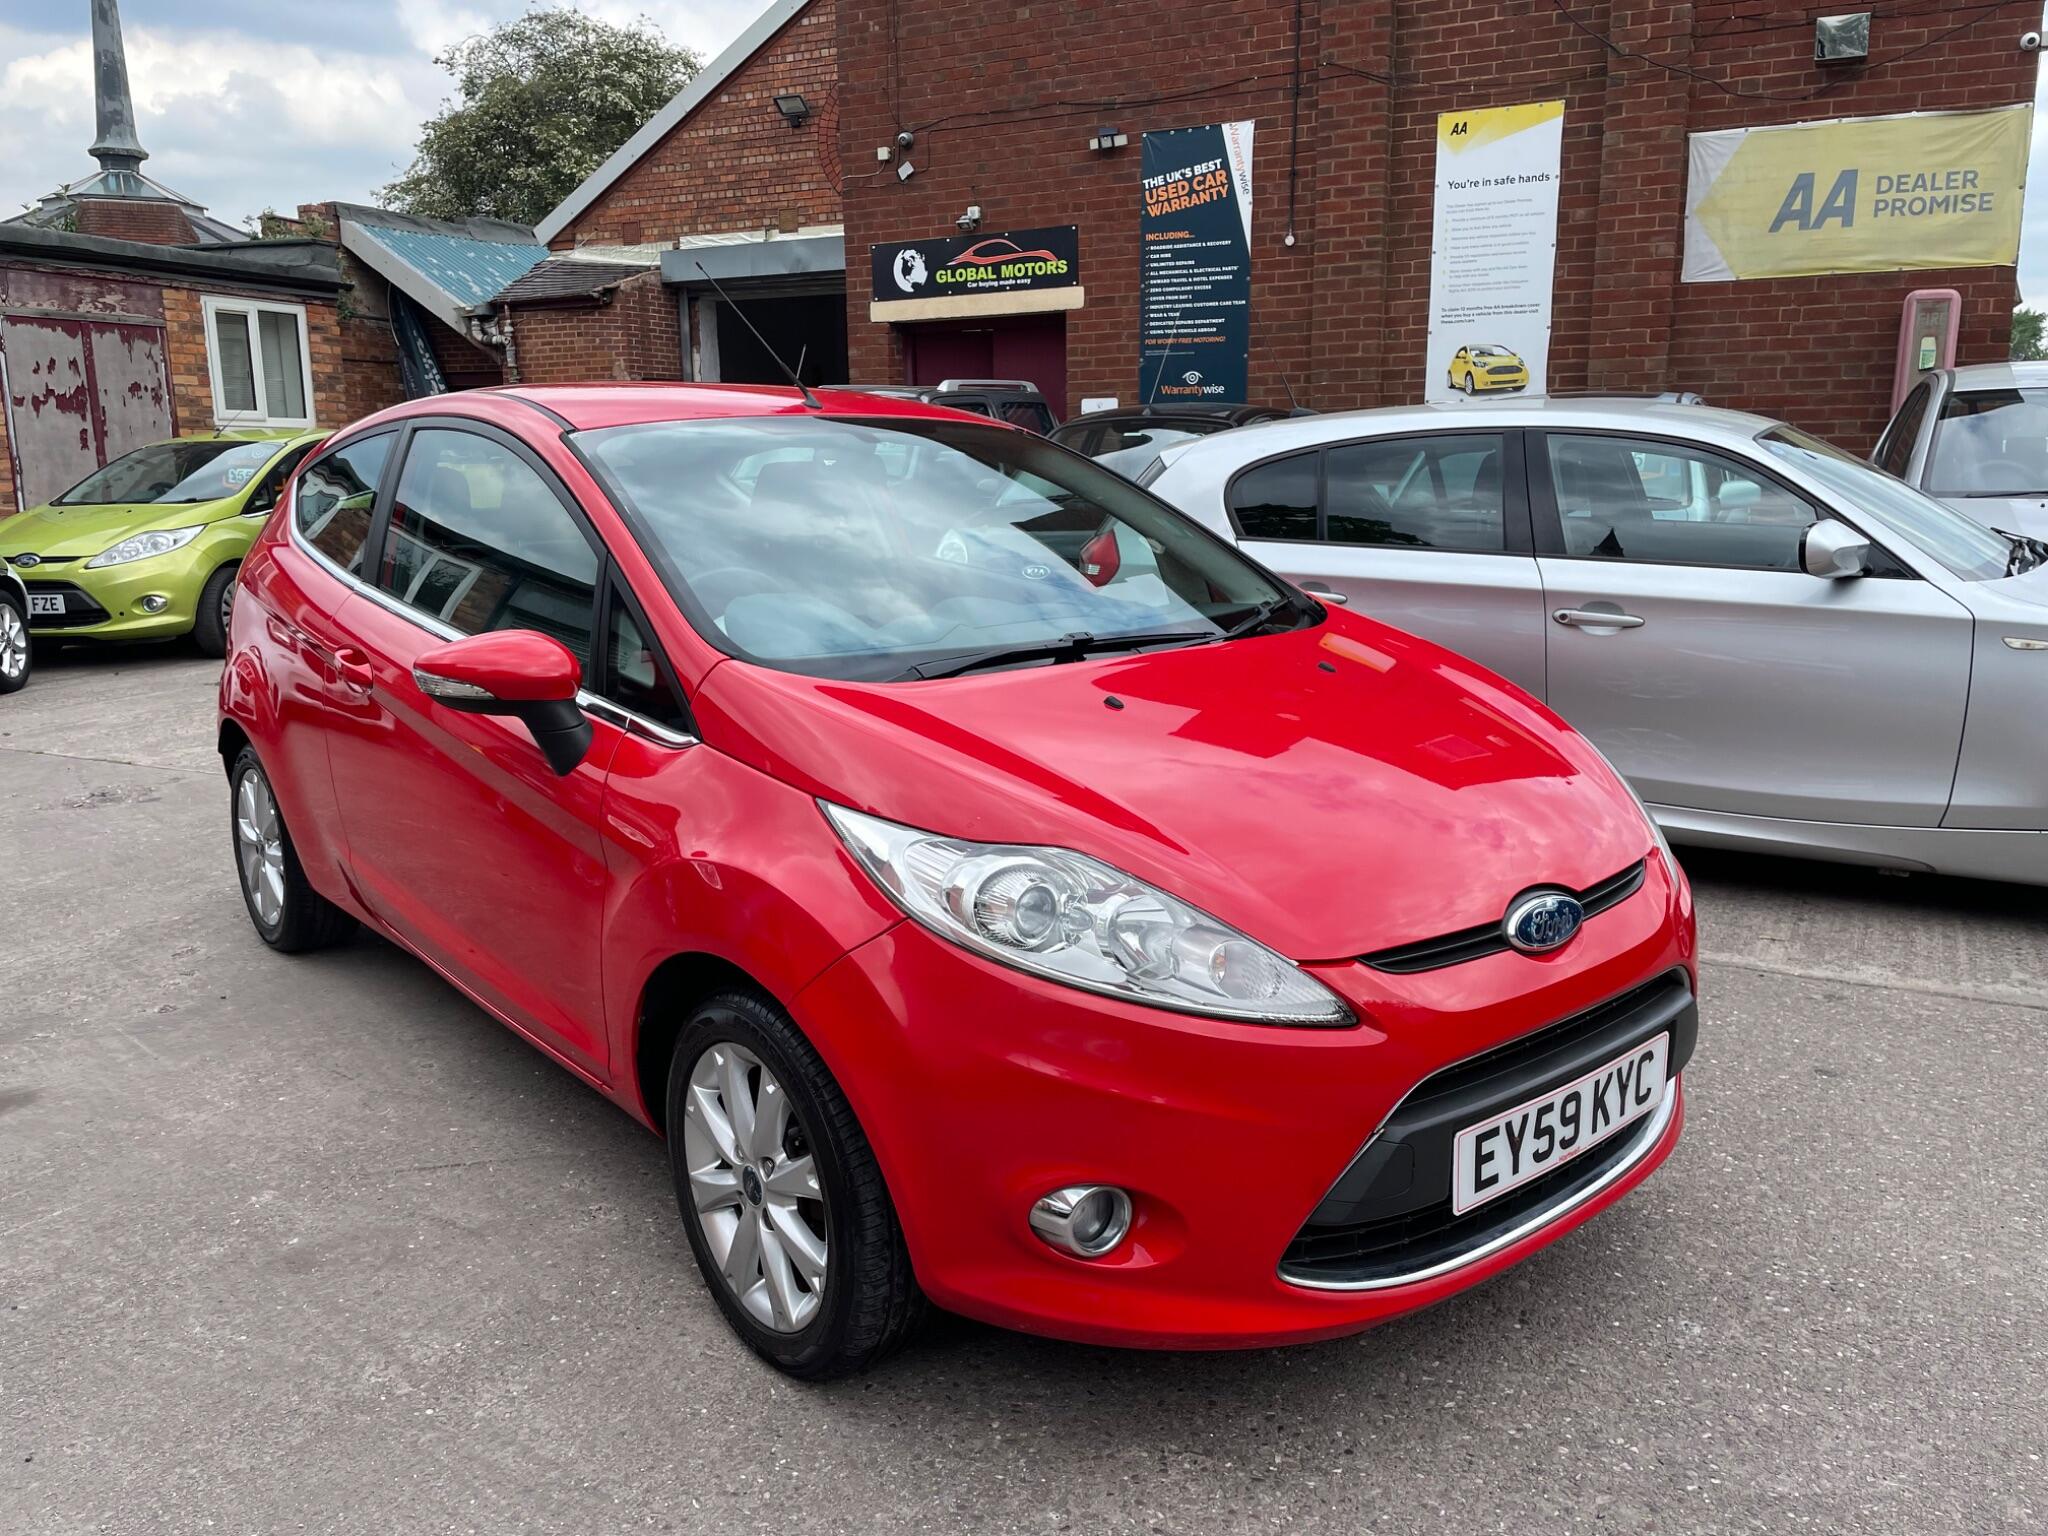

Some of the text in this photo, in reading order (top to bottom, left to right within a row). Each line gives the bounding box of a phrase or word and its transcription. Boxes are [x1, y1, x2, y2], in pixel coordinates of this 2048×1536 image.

[1450, 122, 1467, 136] AA
[1229, 123, 1250, 195] Warrantywise
[1143, 159, 1222, 189] THE UK'S BEST
[1145, 170, 1228, 204] USED CAR
[1448, 173, 1550, 190] You're in safe hands
[1876, 170, 1978, 194] DEALER
[1147, 184, 1228, 218] WARRANTY
[1768, 169, 1858, 233] AA
[1874, 193, 1994, 217] PROMISE
[936, 260, 1068, 283] GLOBAL MOTORS
[1161, 384, 1225, 396] Warrantywise
[32, 597, 59, 611] FZE
[1531, 902, 1573, 940] Ford
[1474, 1050, 1654, 1193] EY59 KYC
